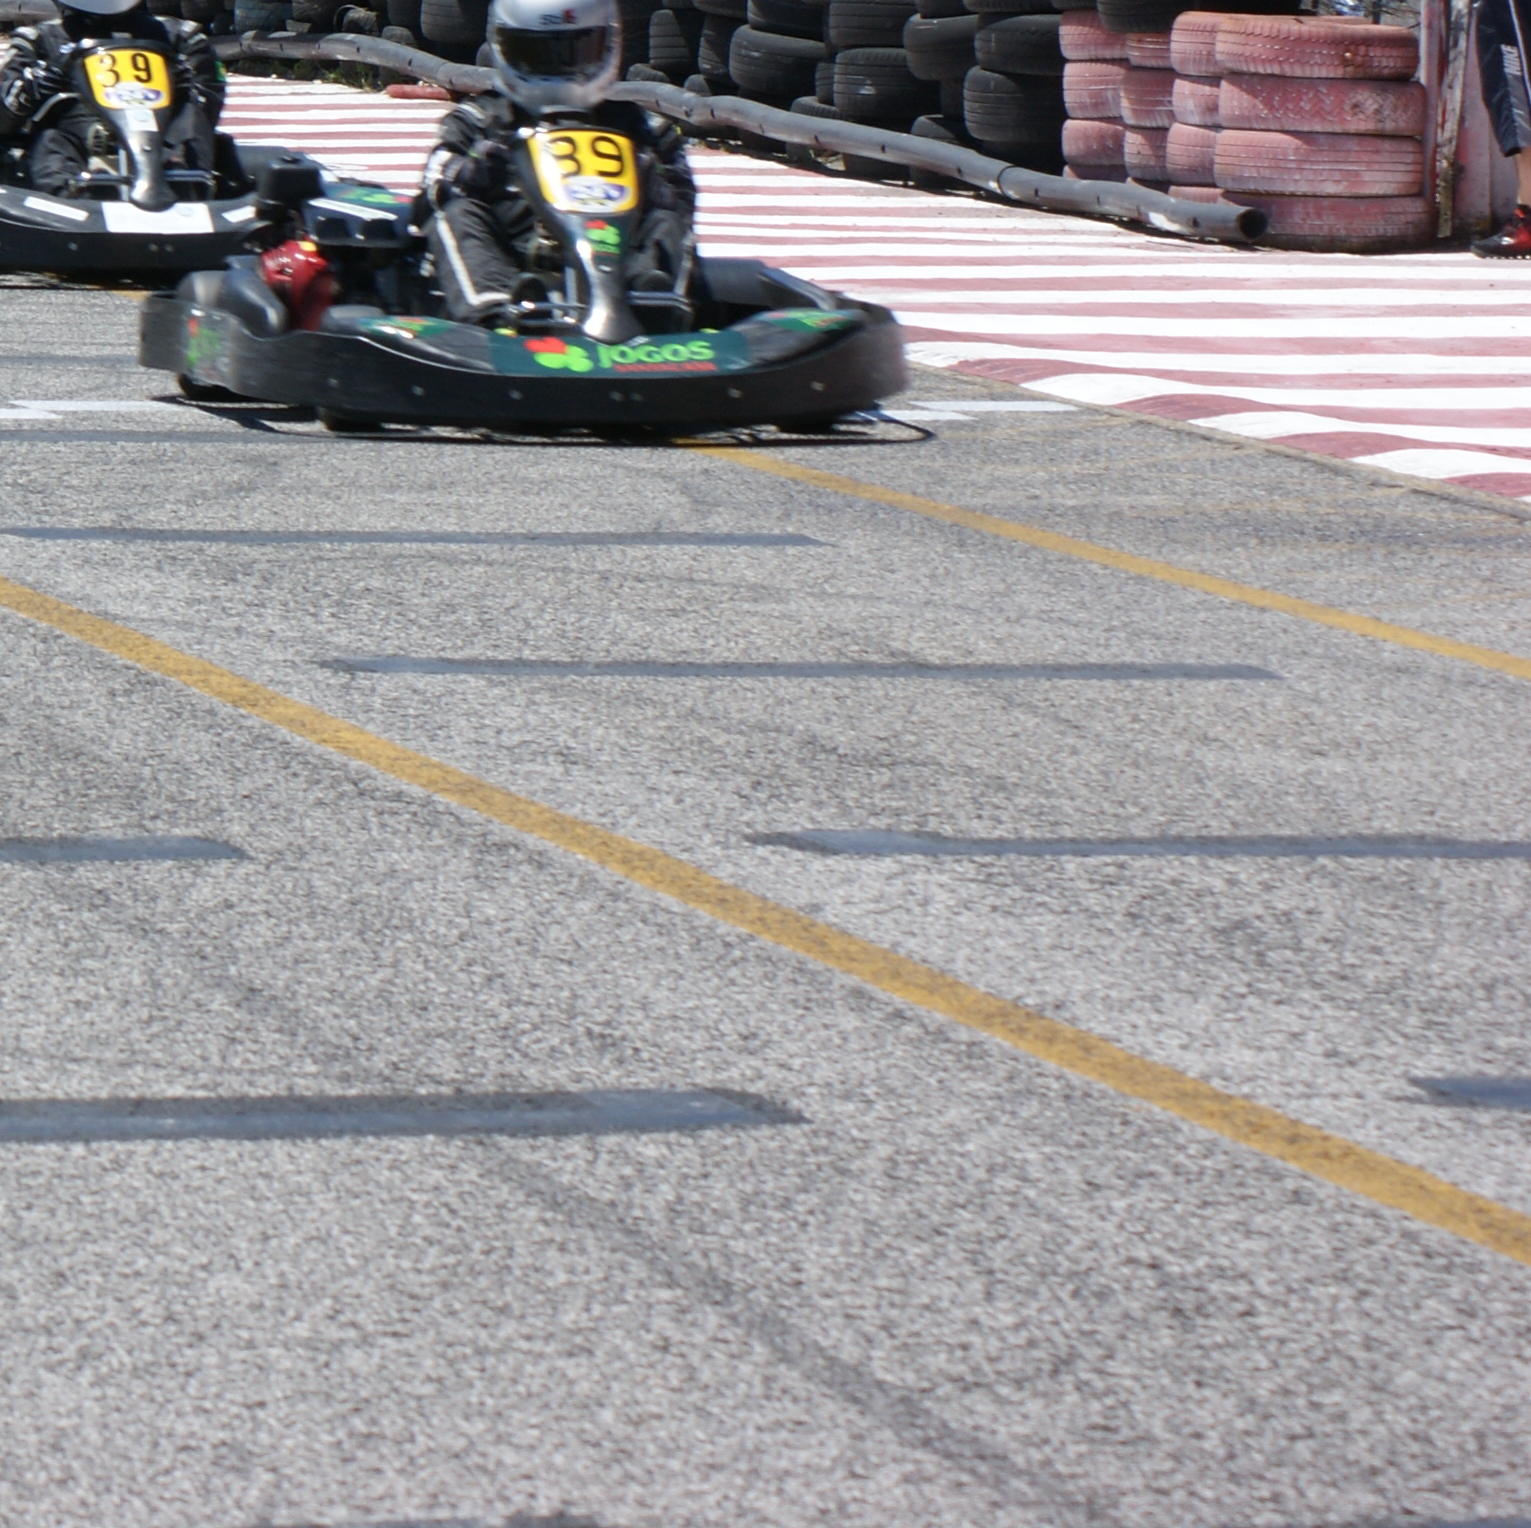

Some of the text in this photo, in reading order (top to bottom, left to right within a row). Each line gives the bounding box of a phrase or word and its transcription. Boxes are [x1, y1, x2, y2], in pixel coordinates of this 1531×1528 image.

[1499, 43, 1523, 76] NIKE
[546, 135, 626, 178] 39
[596, 340, 716, 369] JOGOS
